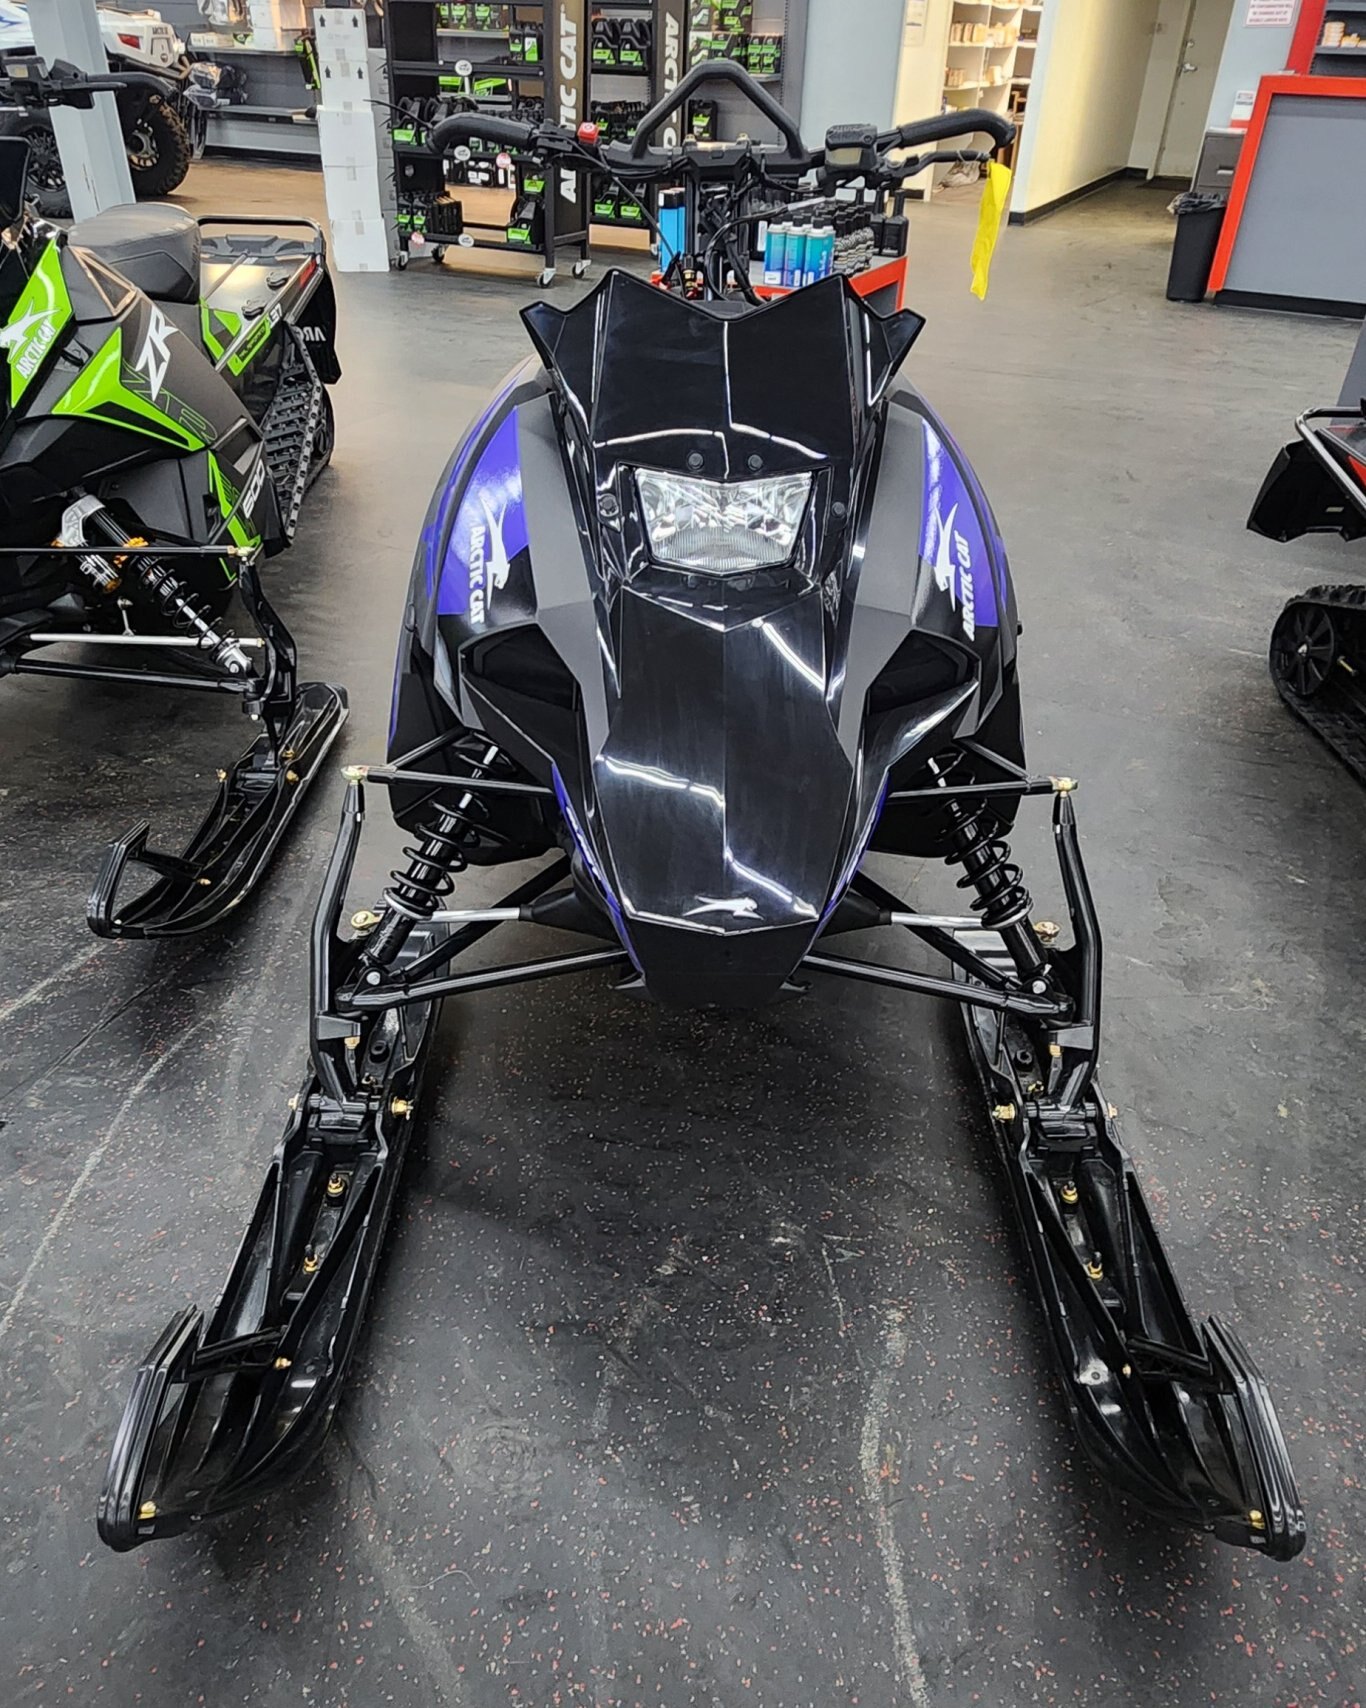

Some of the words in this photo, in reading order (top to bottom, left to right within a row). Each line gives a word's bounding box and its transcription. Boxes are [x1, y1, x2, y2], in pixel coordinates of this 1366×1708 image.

[15, 336, 47, 380] ARCTIC
[37, 318, 57, 343] CAT
[242, 458, 266, 520] 600
[469, 525, 486, 589] ARCTIC
[953, 529, 972, 569] CAT
[469, 589, 485, 625] CAT
[959, 565, 976, 642] ARCTIC
